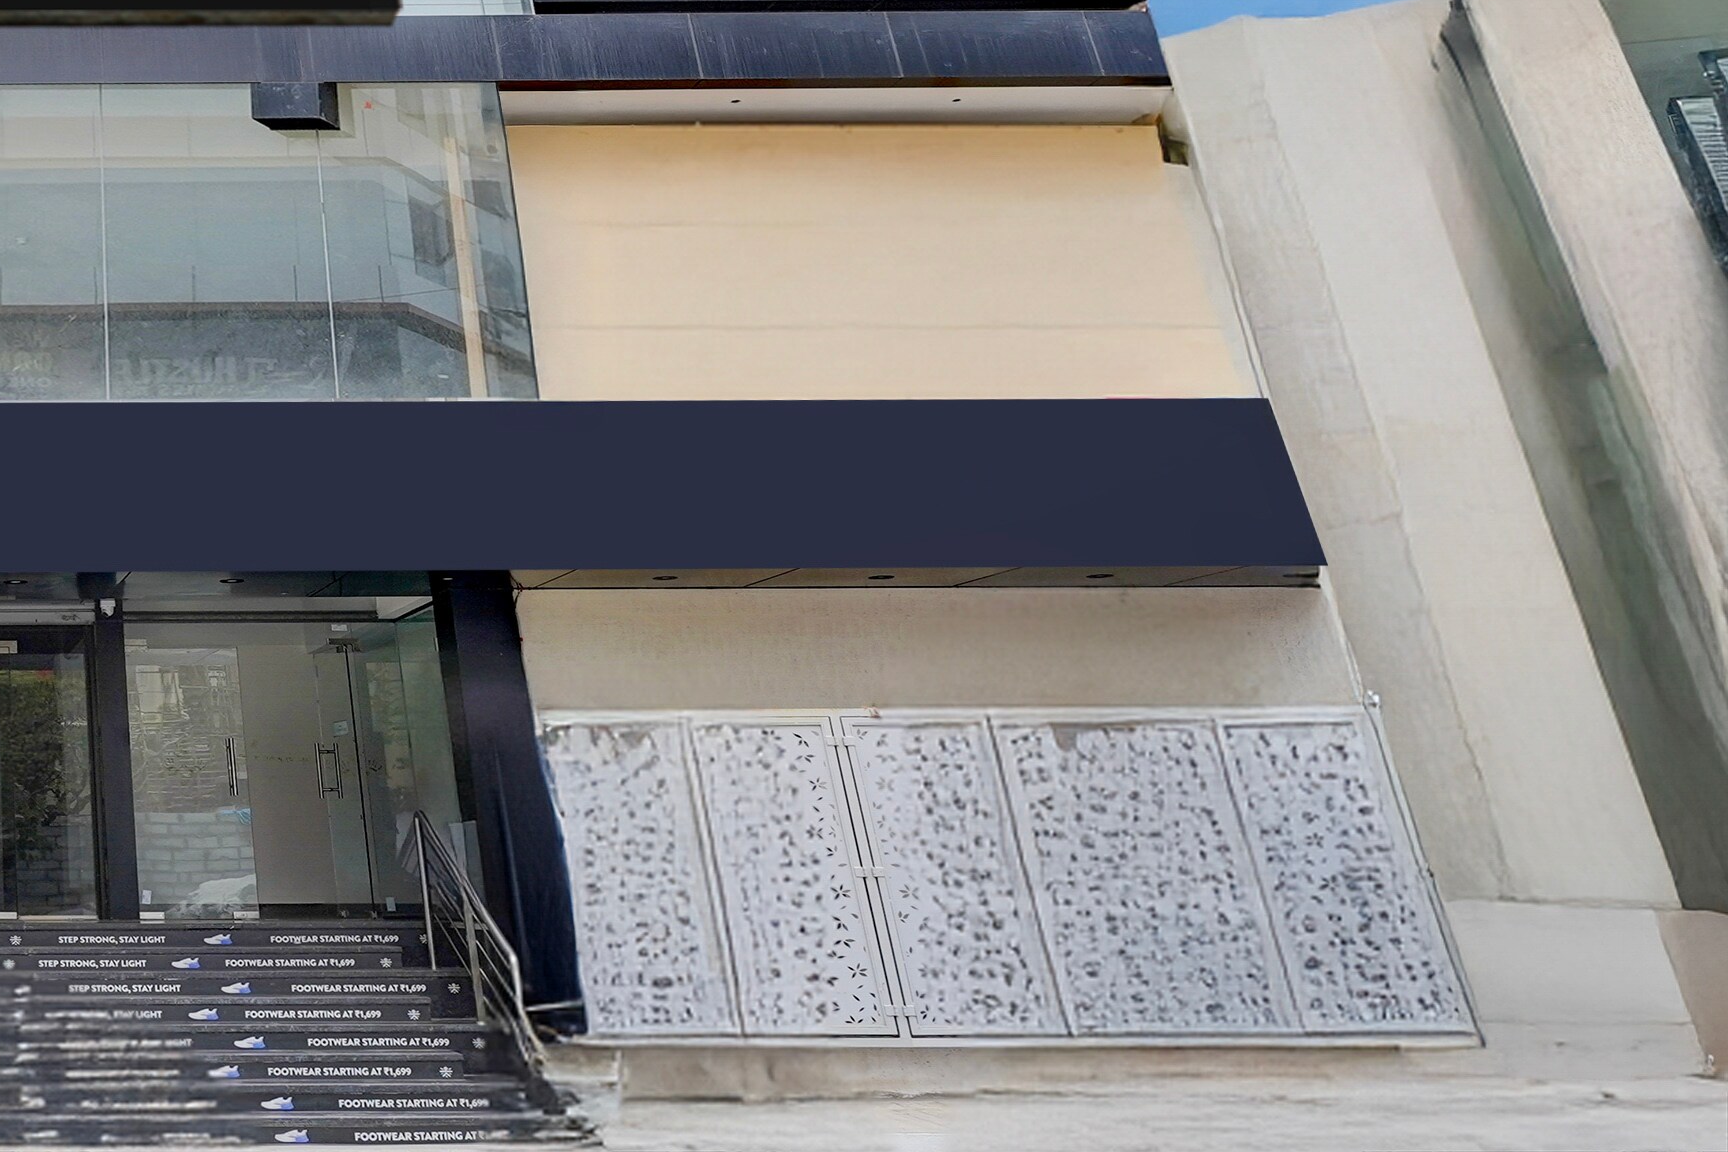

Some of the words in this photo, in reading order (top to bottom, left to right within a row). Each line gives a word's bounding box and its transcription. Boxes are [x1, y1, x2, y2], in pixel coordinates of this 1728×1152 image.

[58, 935, 79, 944] STEP
[79, 935, 119, 945] STRONG,
[118, 935, 140, 944] STAY
[140, 935, 166, 944] LIGHT
[270, 934, 319, 944] FOOTWEAR
[319, 934, 362, 944] STARTING
[362, 934, 373, 944] AT
[373, 934, 399, 945] ₹1,699
[38, 959, 60, 968] STEP
[59, 959, 99, 969] STRONG,
[99, 959, 120, 968] STAY
[120, 959, 147, 968] LIGHT
[224, 958, 274, 968] FOOTWEAR
[274, 958, 317, 968] STARTING
[317, 958, 329, 968] AT
[329, 958, 356, 969] ₹1,699
[68, 984, 91, 993] STEP
[90, 984, 132, 994] STRONG,
[131, 984, 154, 993] STAY
[154, 984, 182, 993] LIGHT
[291, 983, 342, 993] FOOTWEAR
[342, 983, 387, 993] STARTING
[387, 983, 399, 993] AT
[399, 983, 427, 994] ₹1,699
[244, 1009, 296, 1019] FOOTWEAR
[296, 1009, 342, 1019] STARTING
[342, 1009, 354, 1019] AT
[354, 1009, 382, 1020] ₹1,699
[307, 1037, 361, 1047] FOOTWEAR
[361, 1037, 408, 1047] STARTING
[408, 1037, 421, 1047] AT
[421, 1037, 450, 1048] ₹1,699
[267, 1066, 322, 1076] FOOTWEAR
[322, 1066, 370, 1076] STARTING
[370, 1066, 383, 1076] AT
[383, 1066, 412, 1077] ₹1,699
[338, 1098, 395, 1108] FOOTWEAR
[395, 1098, 445, 1108] STARTING
[445, 1098, 458, 1108] AT
[354, 1131, 412, 1141] FOOTWEAR
[413, 1131, 463, 1141] STARTING
[464, 1131, 477, 1141] AT
